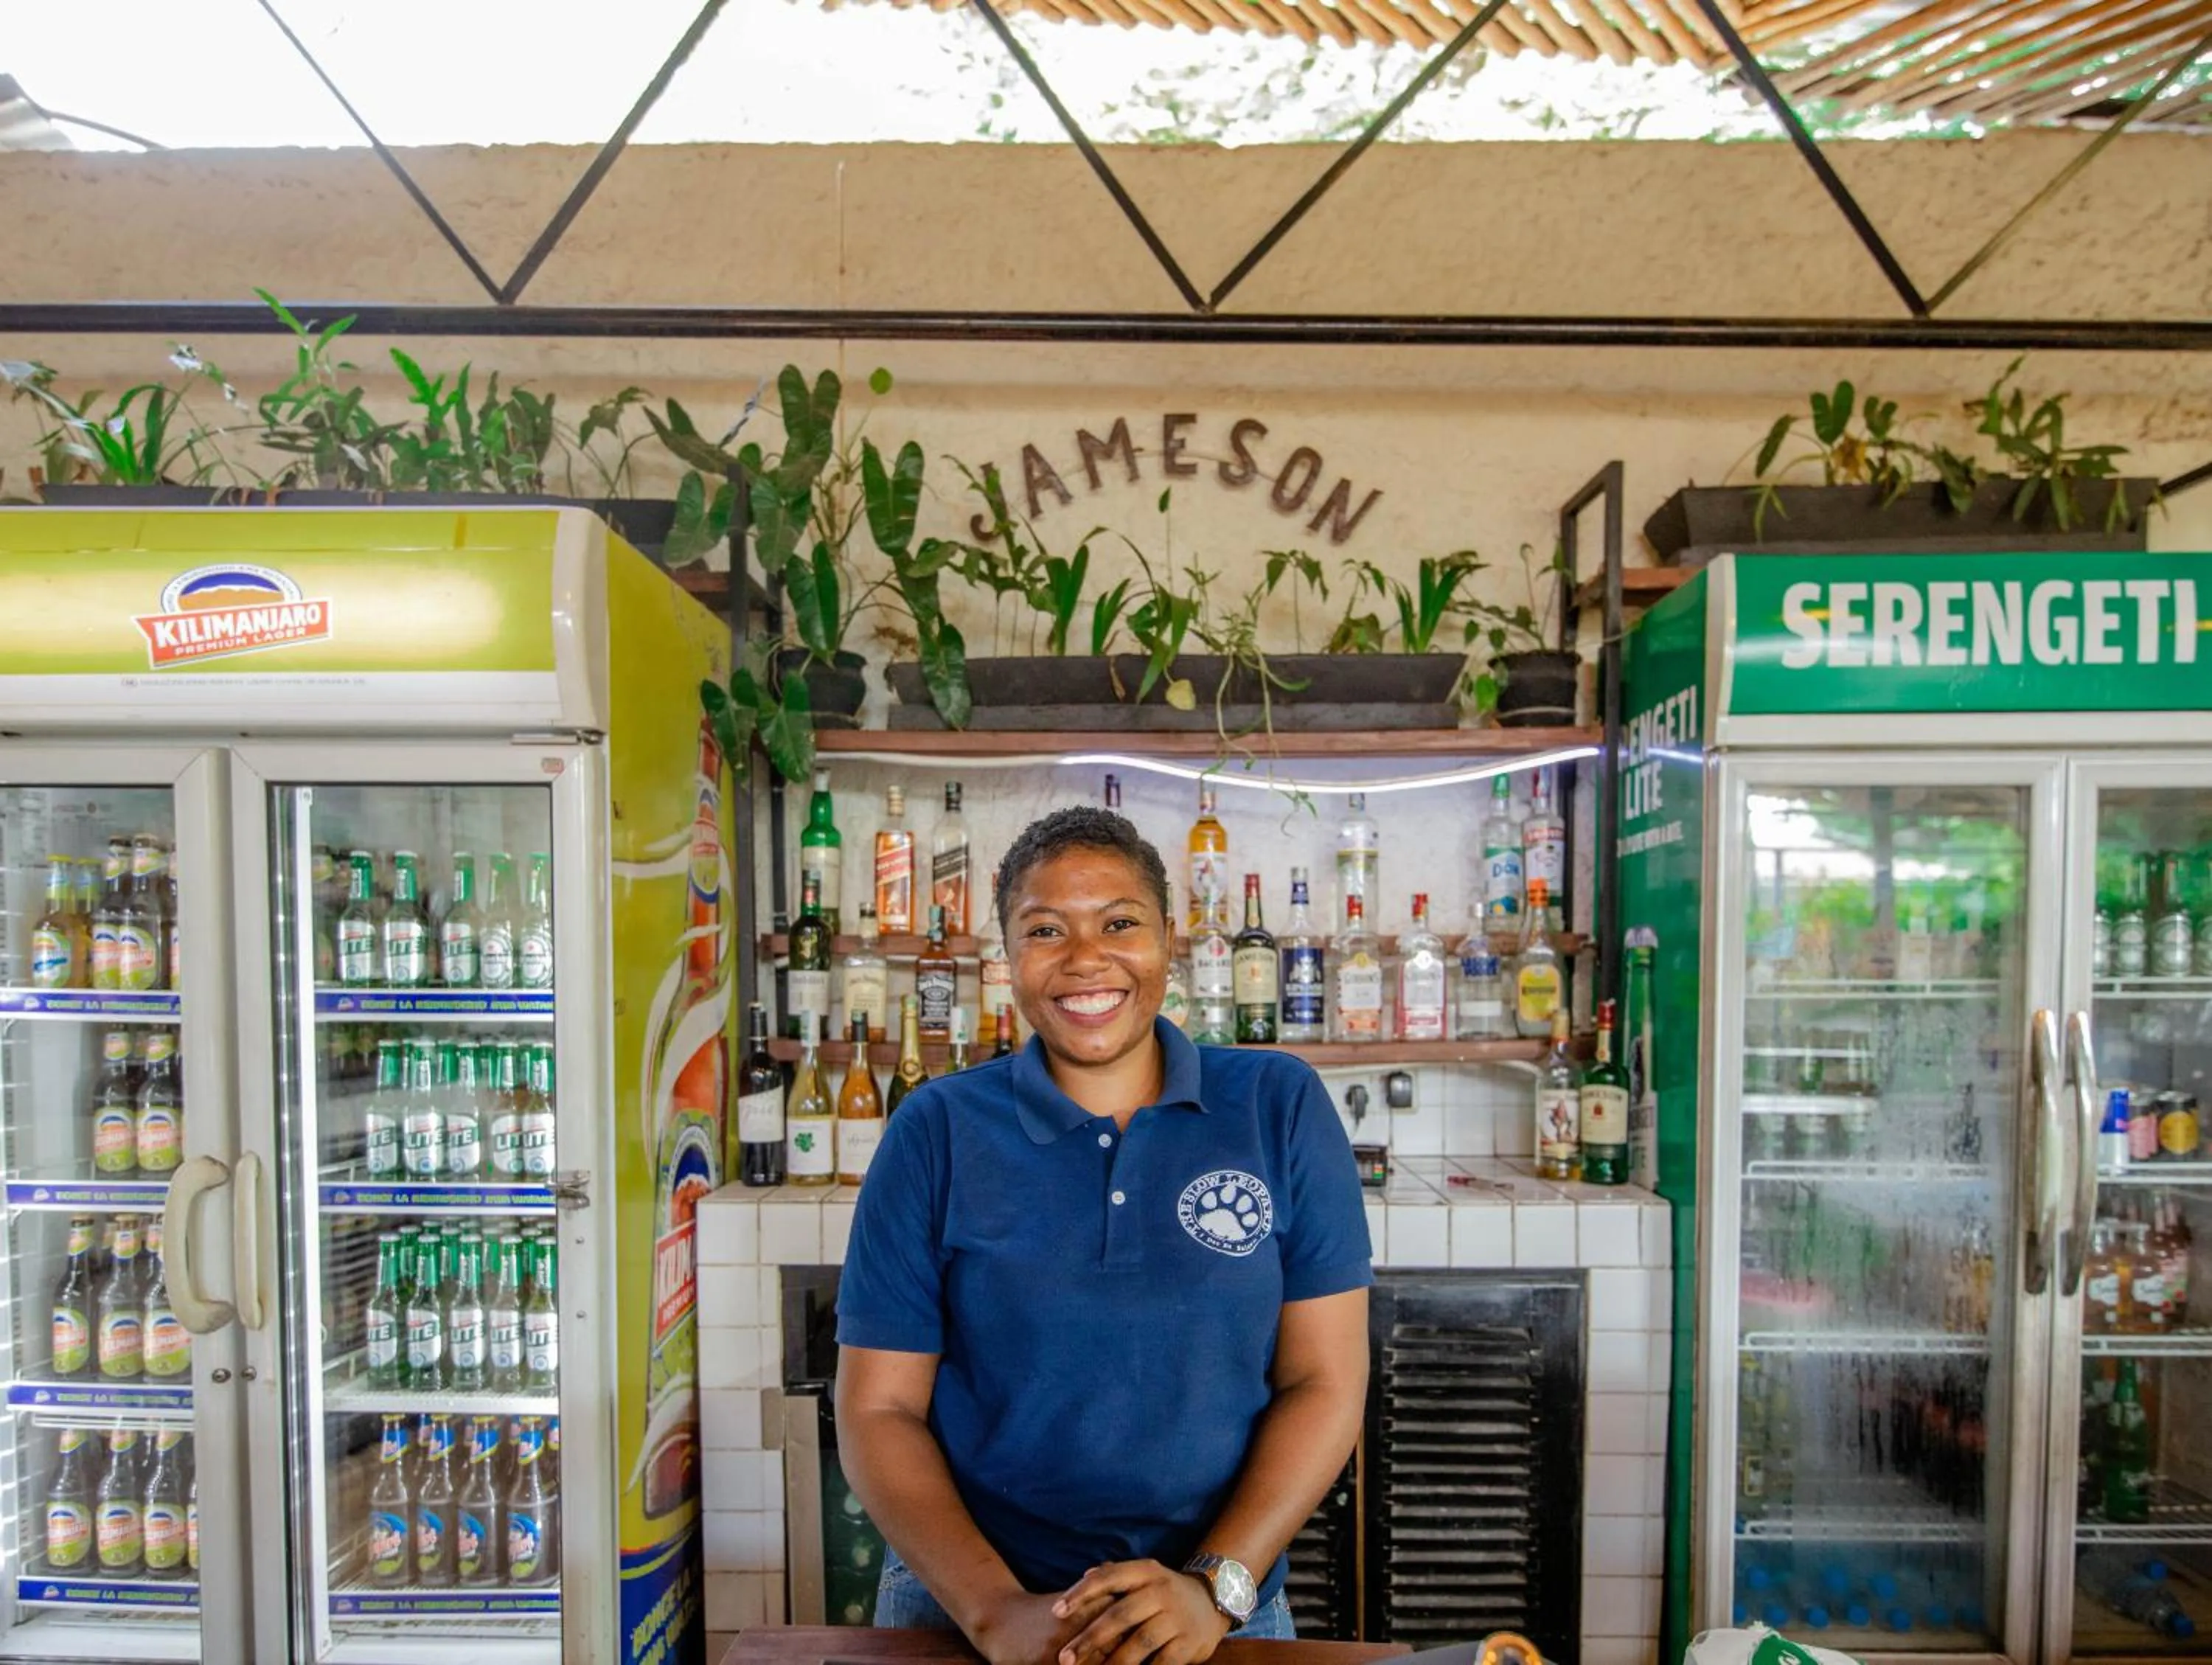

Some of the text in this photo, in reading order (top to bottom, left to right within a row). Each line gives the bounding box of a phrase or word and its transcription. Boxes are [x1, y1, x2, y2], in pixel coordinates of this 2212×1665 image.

[970, 412, 1384, 546] JAMESON
[153, 604, 321, 649] KILIMANJARO
[174, 627, 307, 656] PREMIUM LAGER
[1781, 579, 2198, 669] SERENGETI
[1624, 759, 1663, 821] LITE
[1184, 1175, 1220, 1203] SLOW
